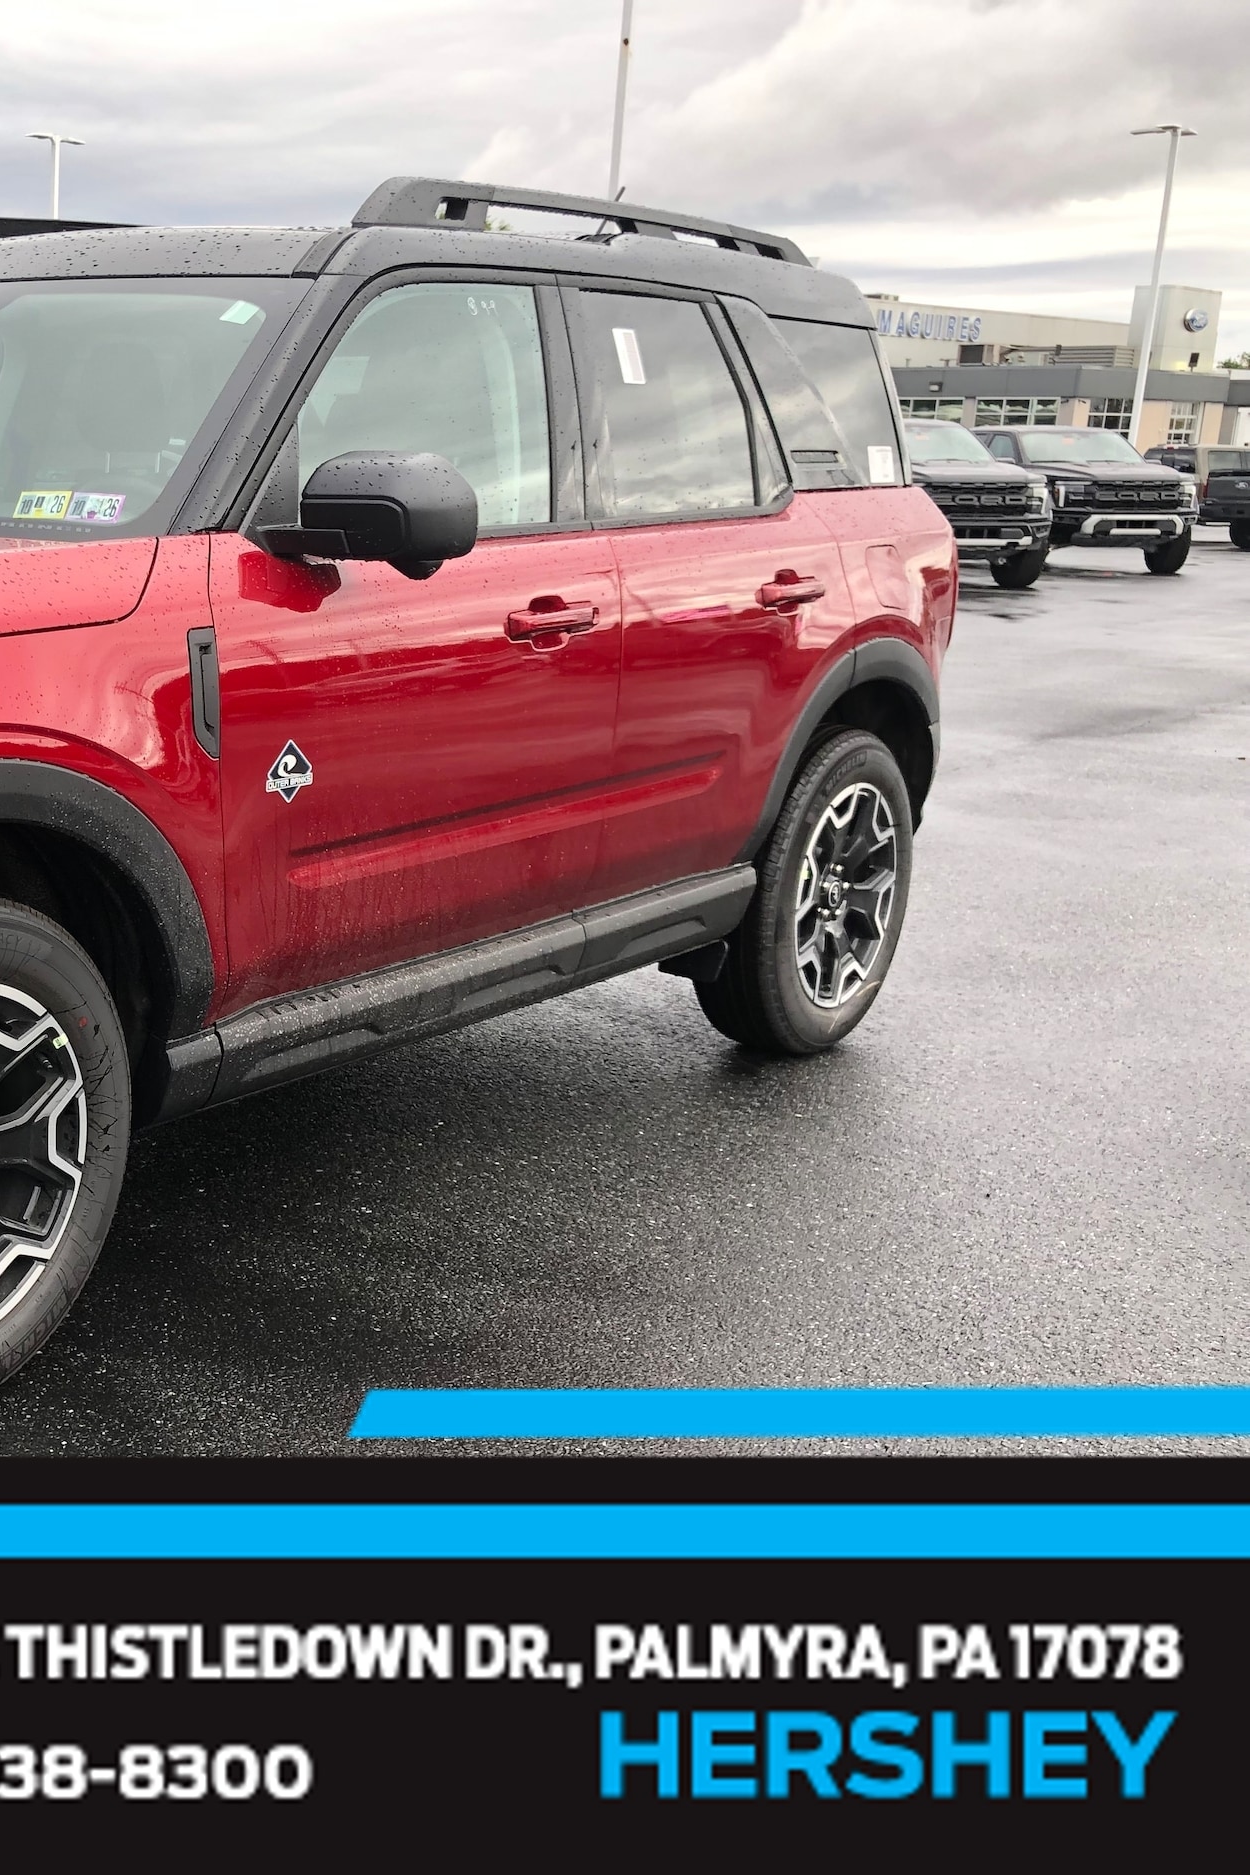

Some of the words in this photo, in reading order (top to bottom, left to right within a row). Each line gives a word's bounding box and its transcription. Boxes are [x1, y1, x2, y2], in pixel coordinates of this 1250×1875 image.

[879, 310, 981, 341] MAGUIRES
[50, 495, 66, 514] 26
[103, 498, 120, 518] 26
